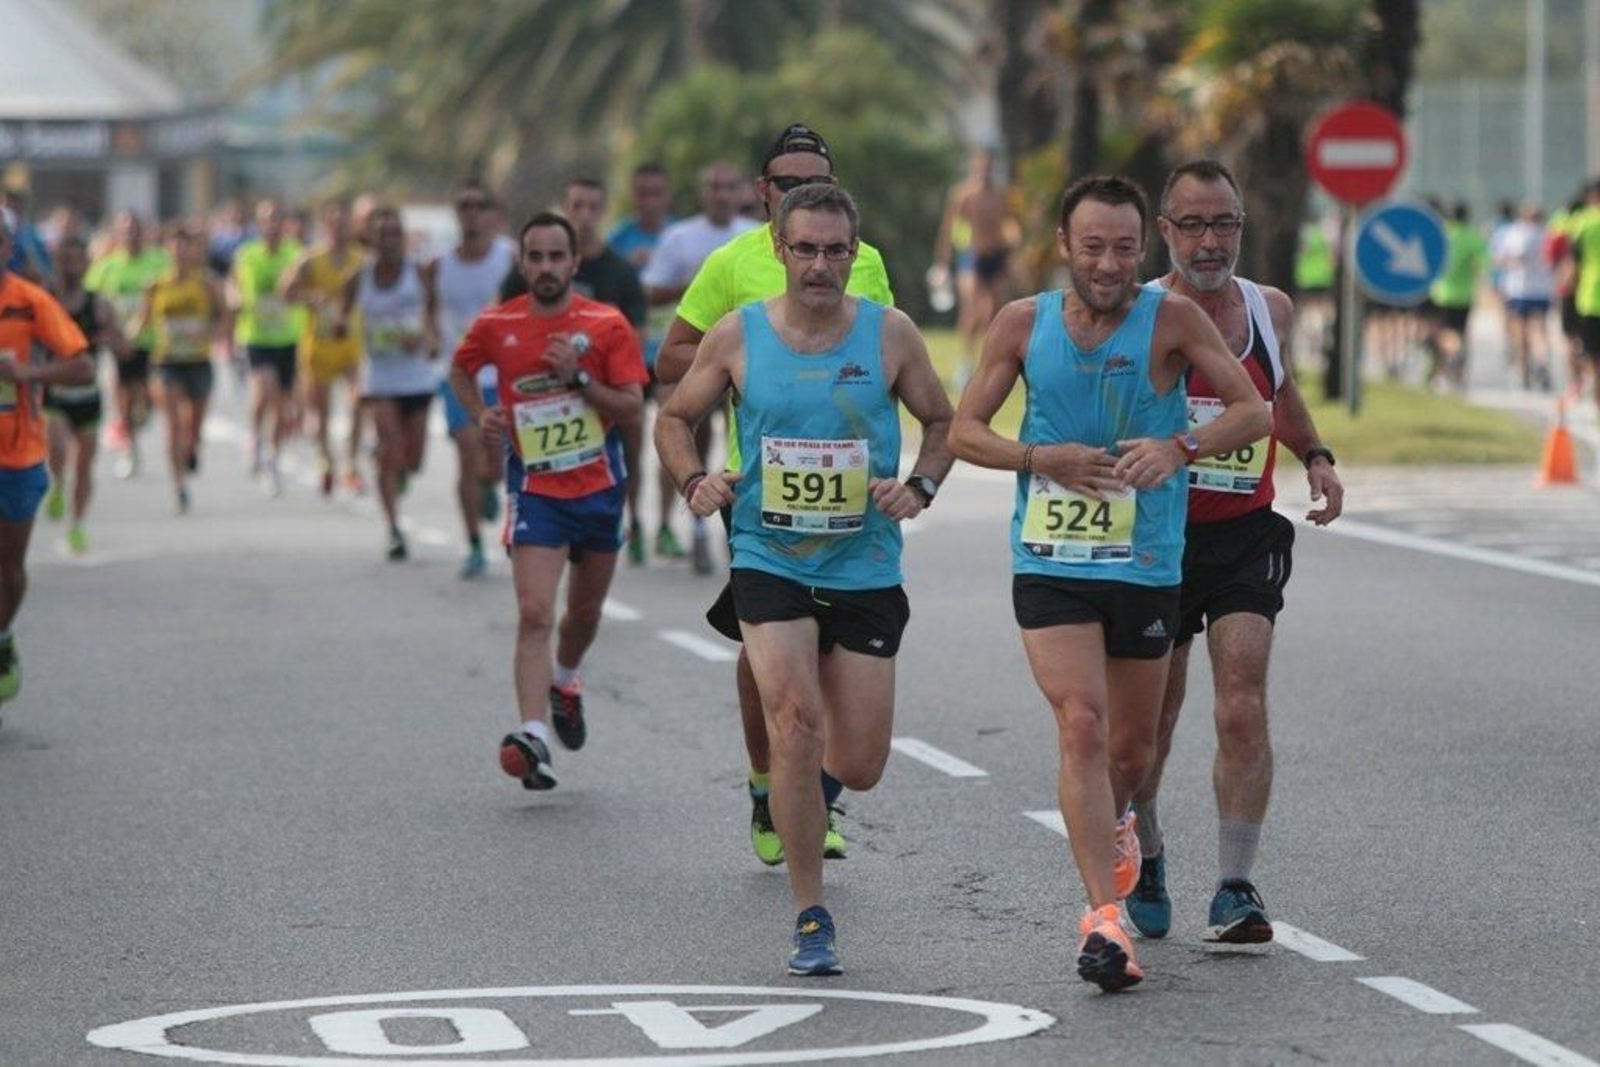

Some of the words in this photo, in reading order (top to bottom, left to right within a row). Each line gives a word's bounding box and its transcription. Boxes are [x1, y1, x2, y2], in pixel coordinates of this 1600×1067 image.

[534, 418, 588, 451] 722
[782, 472, 847, 504] 591
[1046, 500, 1113, 533] 524
[309, 1002, 824, 1055] 40
